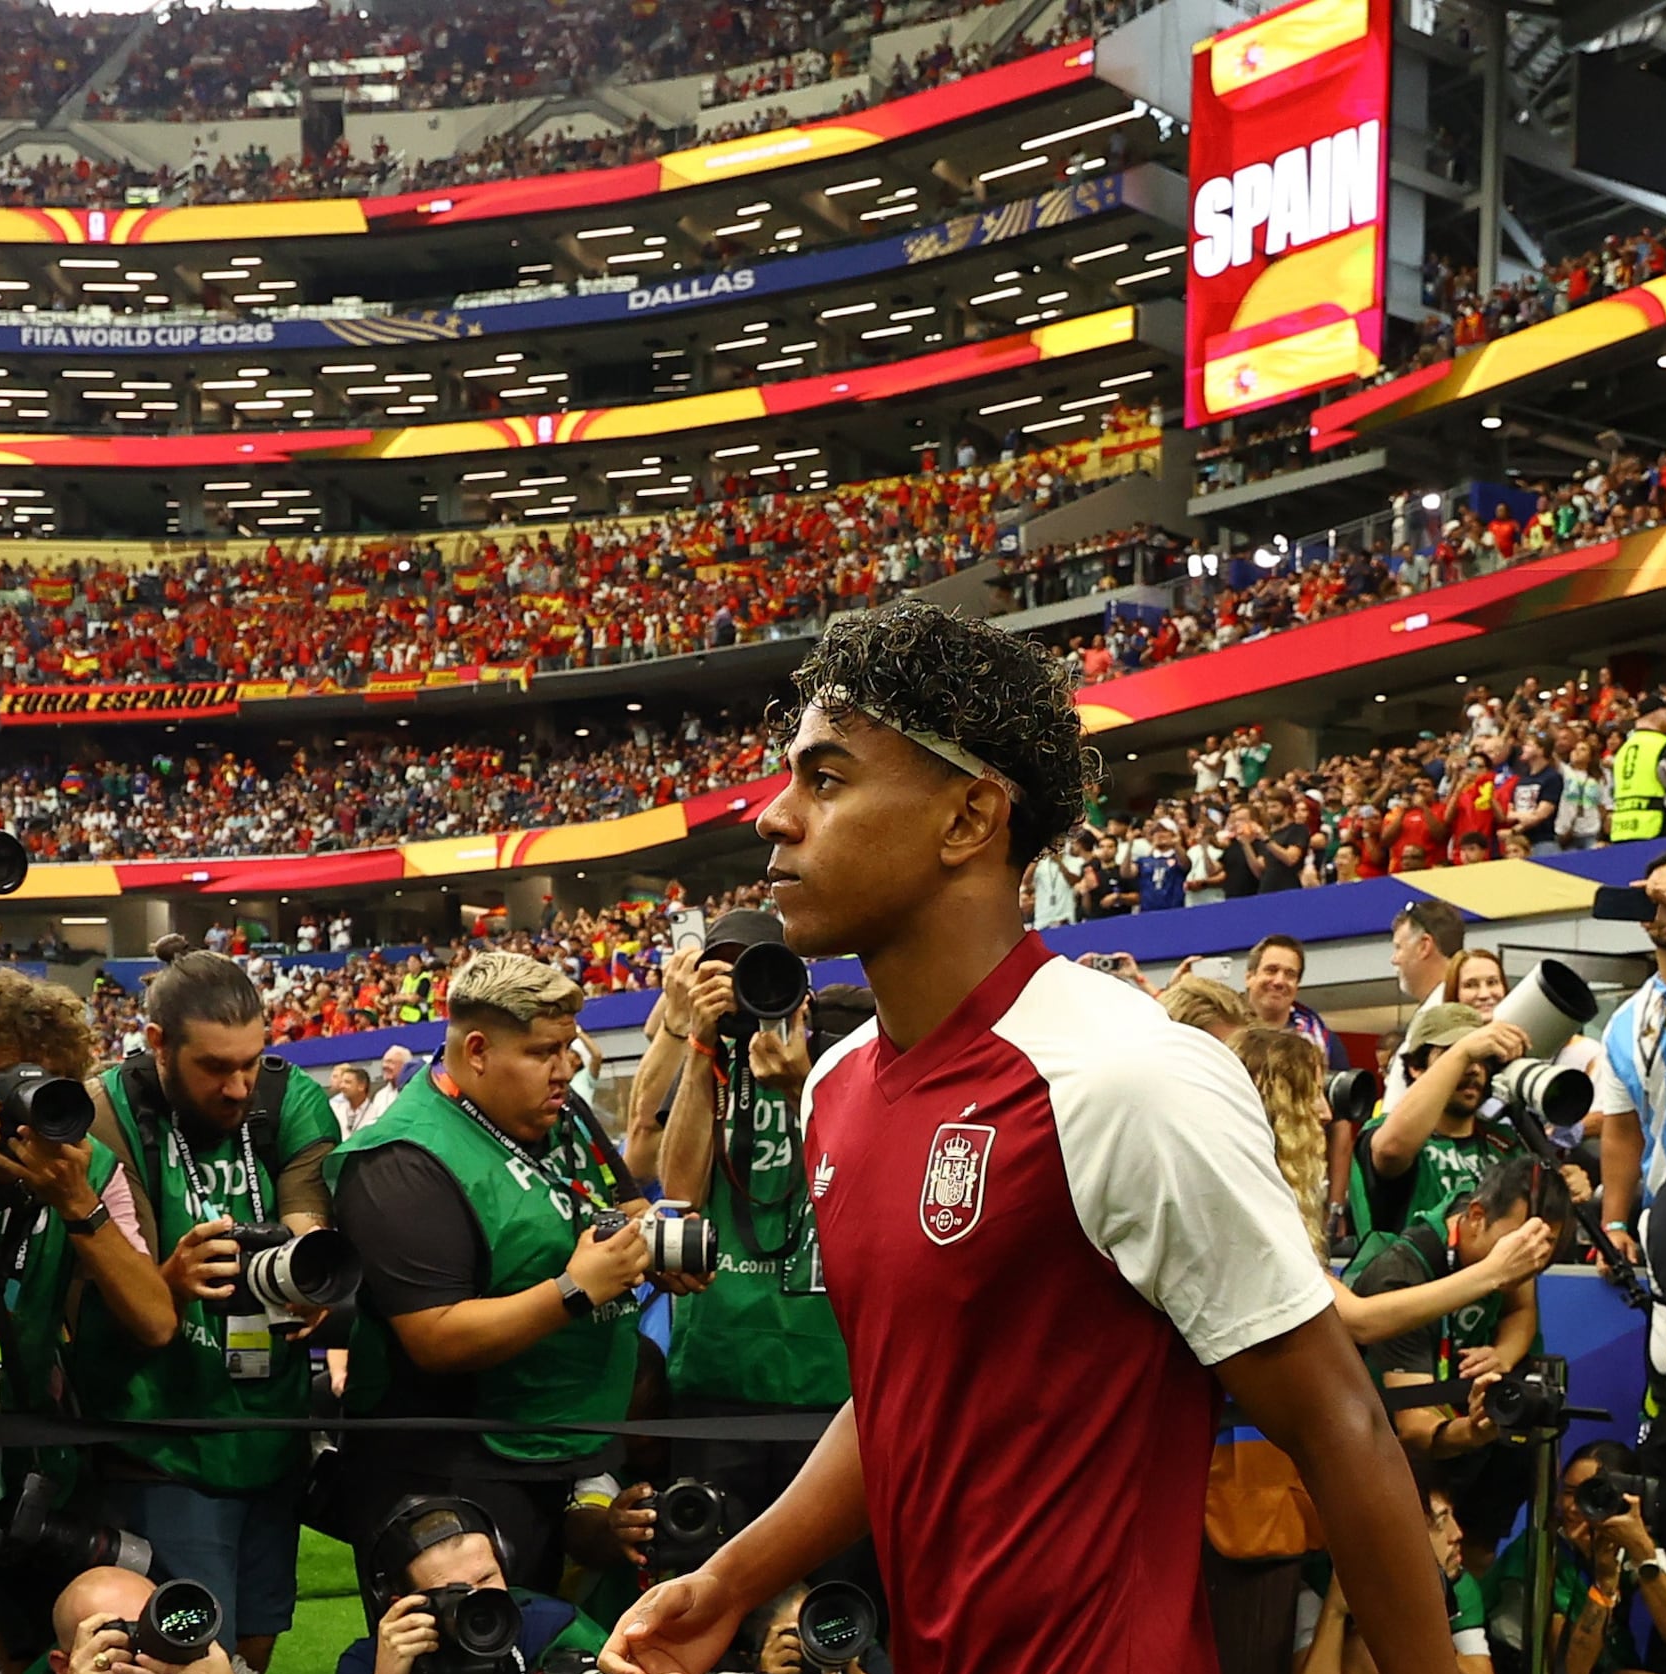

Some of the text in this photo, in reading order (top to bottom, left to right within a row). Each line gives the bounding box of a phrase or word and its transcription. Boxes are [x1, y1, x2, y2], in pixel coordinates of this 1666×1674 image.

[1192, 119, 1375, 278] SPAIN
[627, 270, 755, 309] DALLAS
[21, 323, 274, 346] FIFA WORLD CUP 2026
[5, 691, 91, 716] FURIA
[739, 1067, 751, 1110] Canon
[461, 1099, 476, 1117] FIFA
[499, 1134, 517, 1152] CUP
[244, 1141, 257, 1174] WORLD
[249, 1172, 261, 1193] CUP
